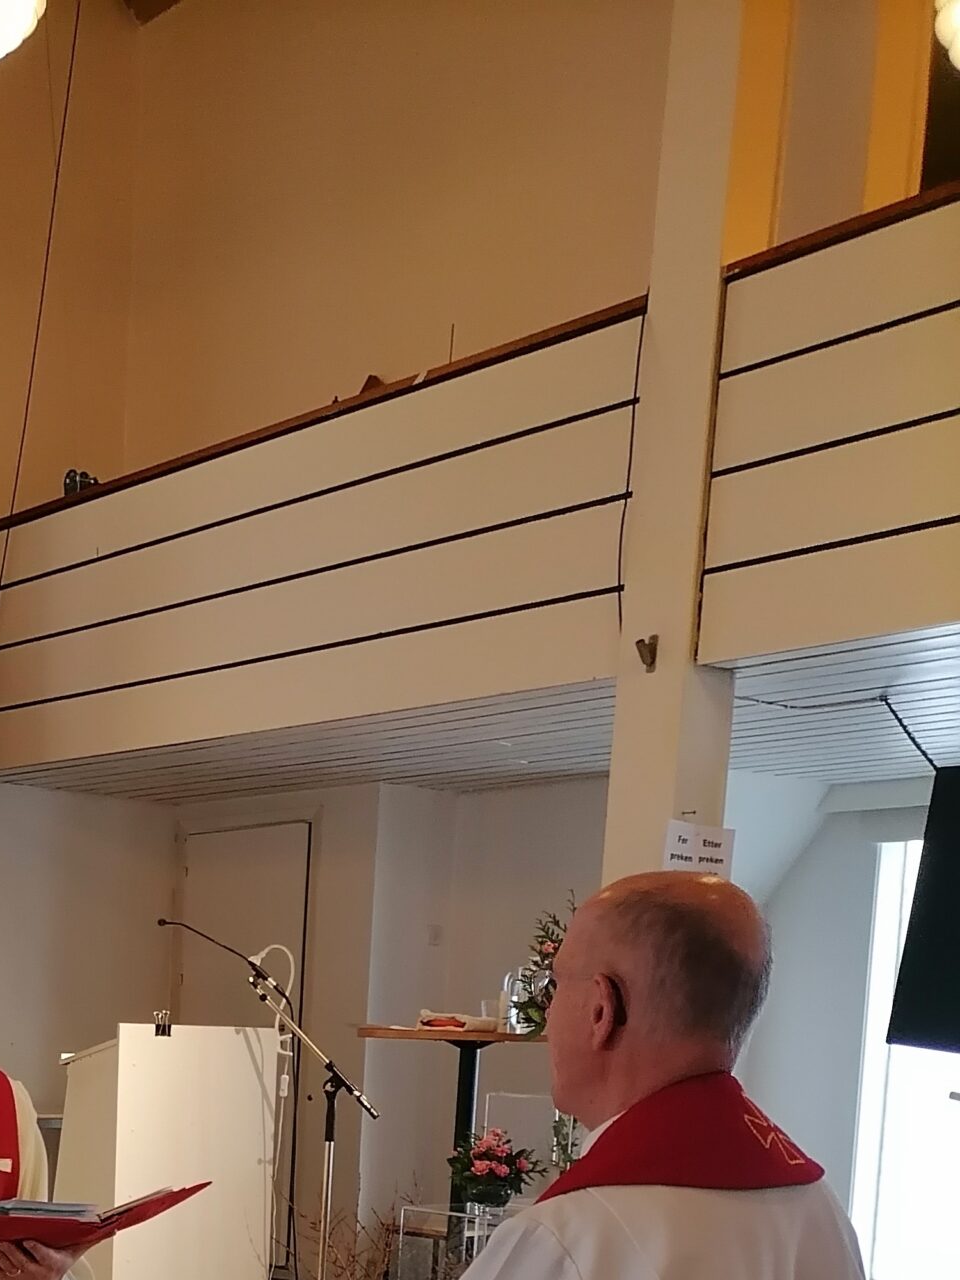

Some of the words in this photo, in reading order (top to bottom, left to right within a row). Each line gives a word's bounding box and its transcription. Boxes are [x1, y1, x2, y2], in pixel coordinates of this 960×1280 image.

[702, 839, 722, 848] Etter
[670, 853, 693, 862] preken
[698, 856, 724, 864] preken
